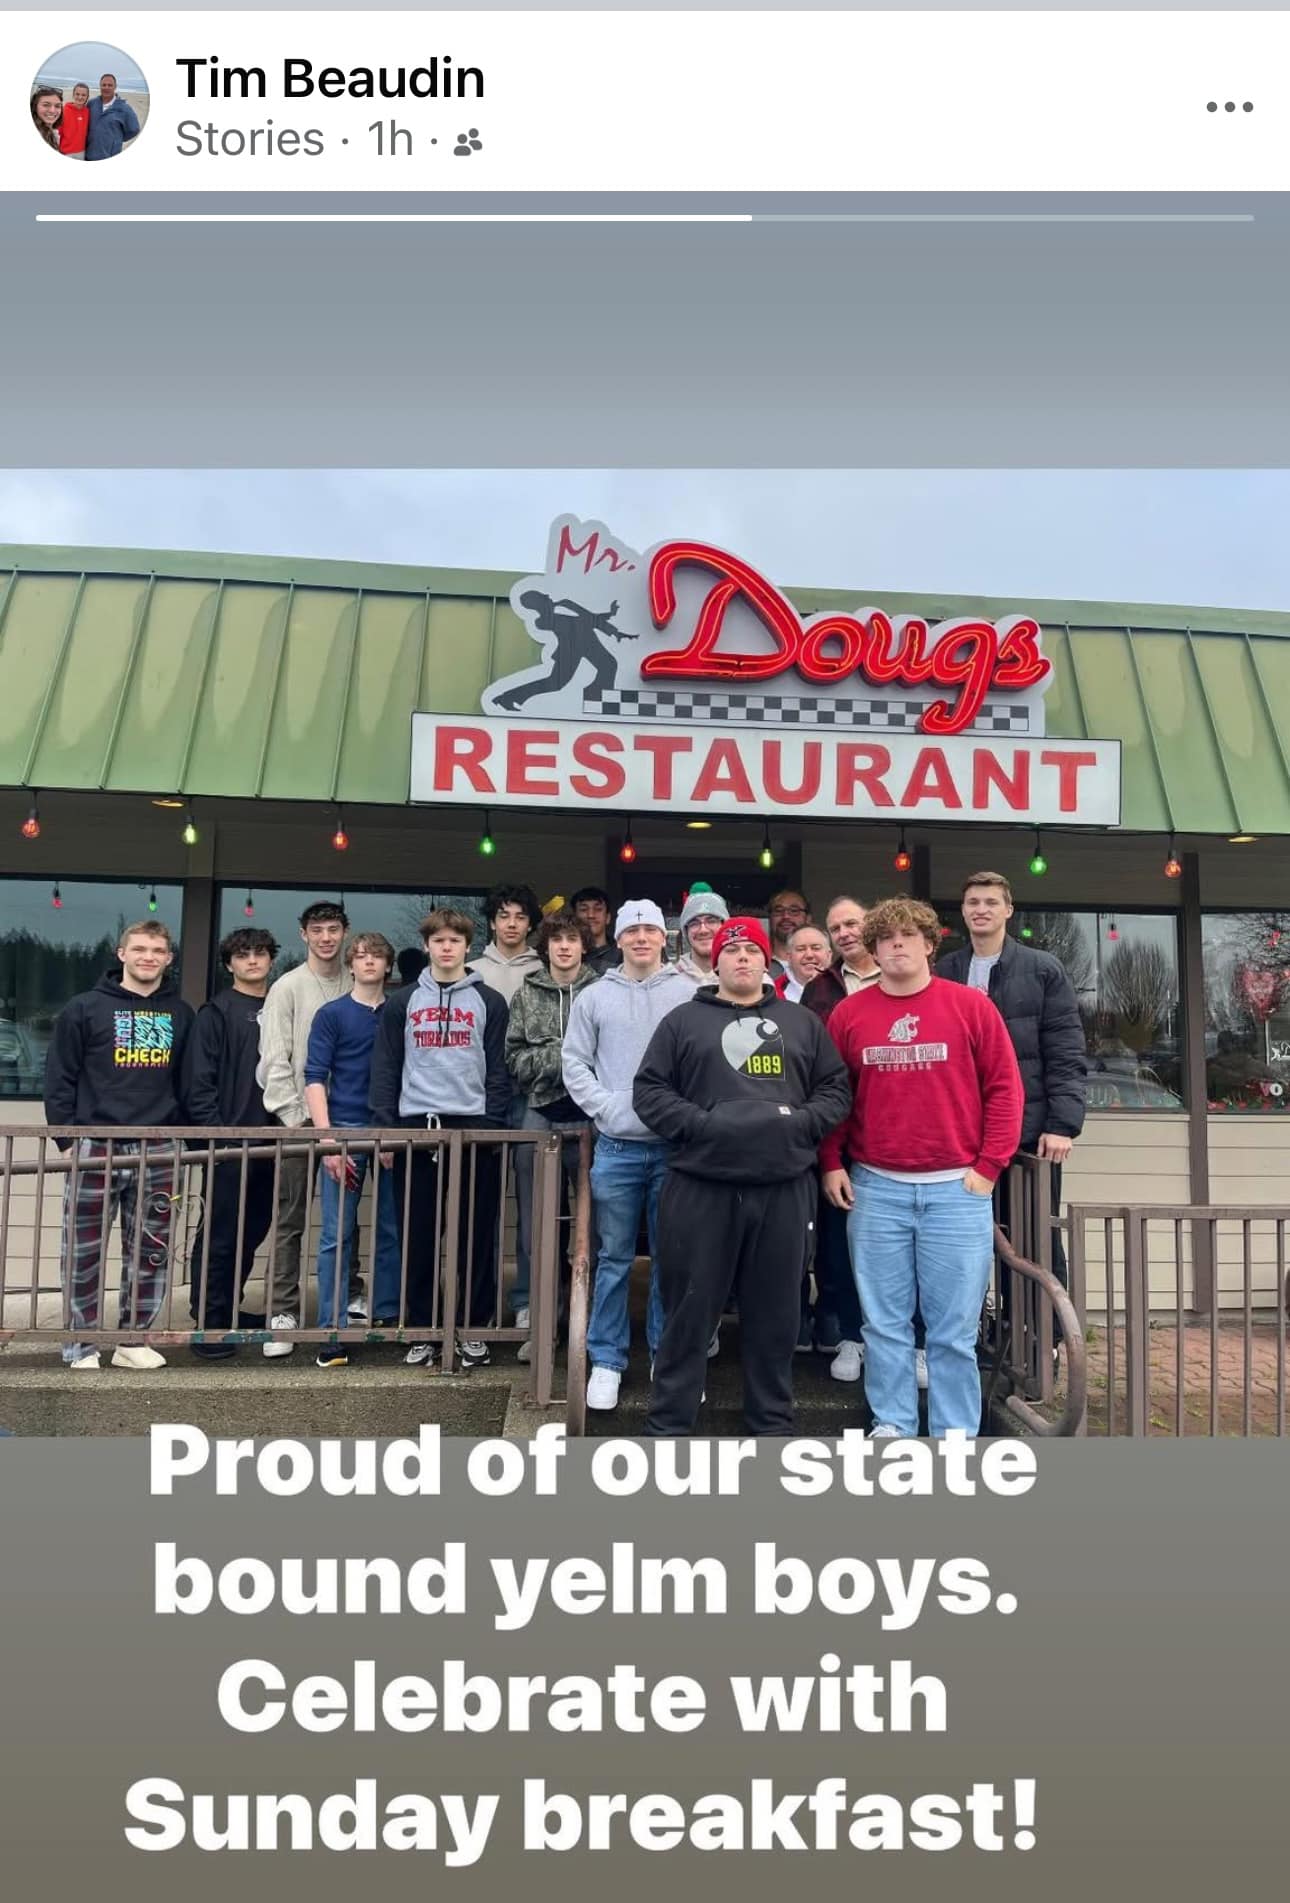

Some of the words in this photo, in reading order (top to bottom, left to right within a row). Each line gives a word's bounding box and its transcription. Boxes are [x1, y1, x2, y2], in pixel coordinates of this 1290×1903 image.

[556, 524, 636, 576] Mr.
[640, 541, 1052, 735] Dougs
[432, 725, 1098, 814] RESTAURANT
[410, 1007, 475, 1028] YELM
[114, 1047, 171, 1064] CHECK
[746, 1055, 782, 1074] 1889
